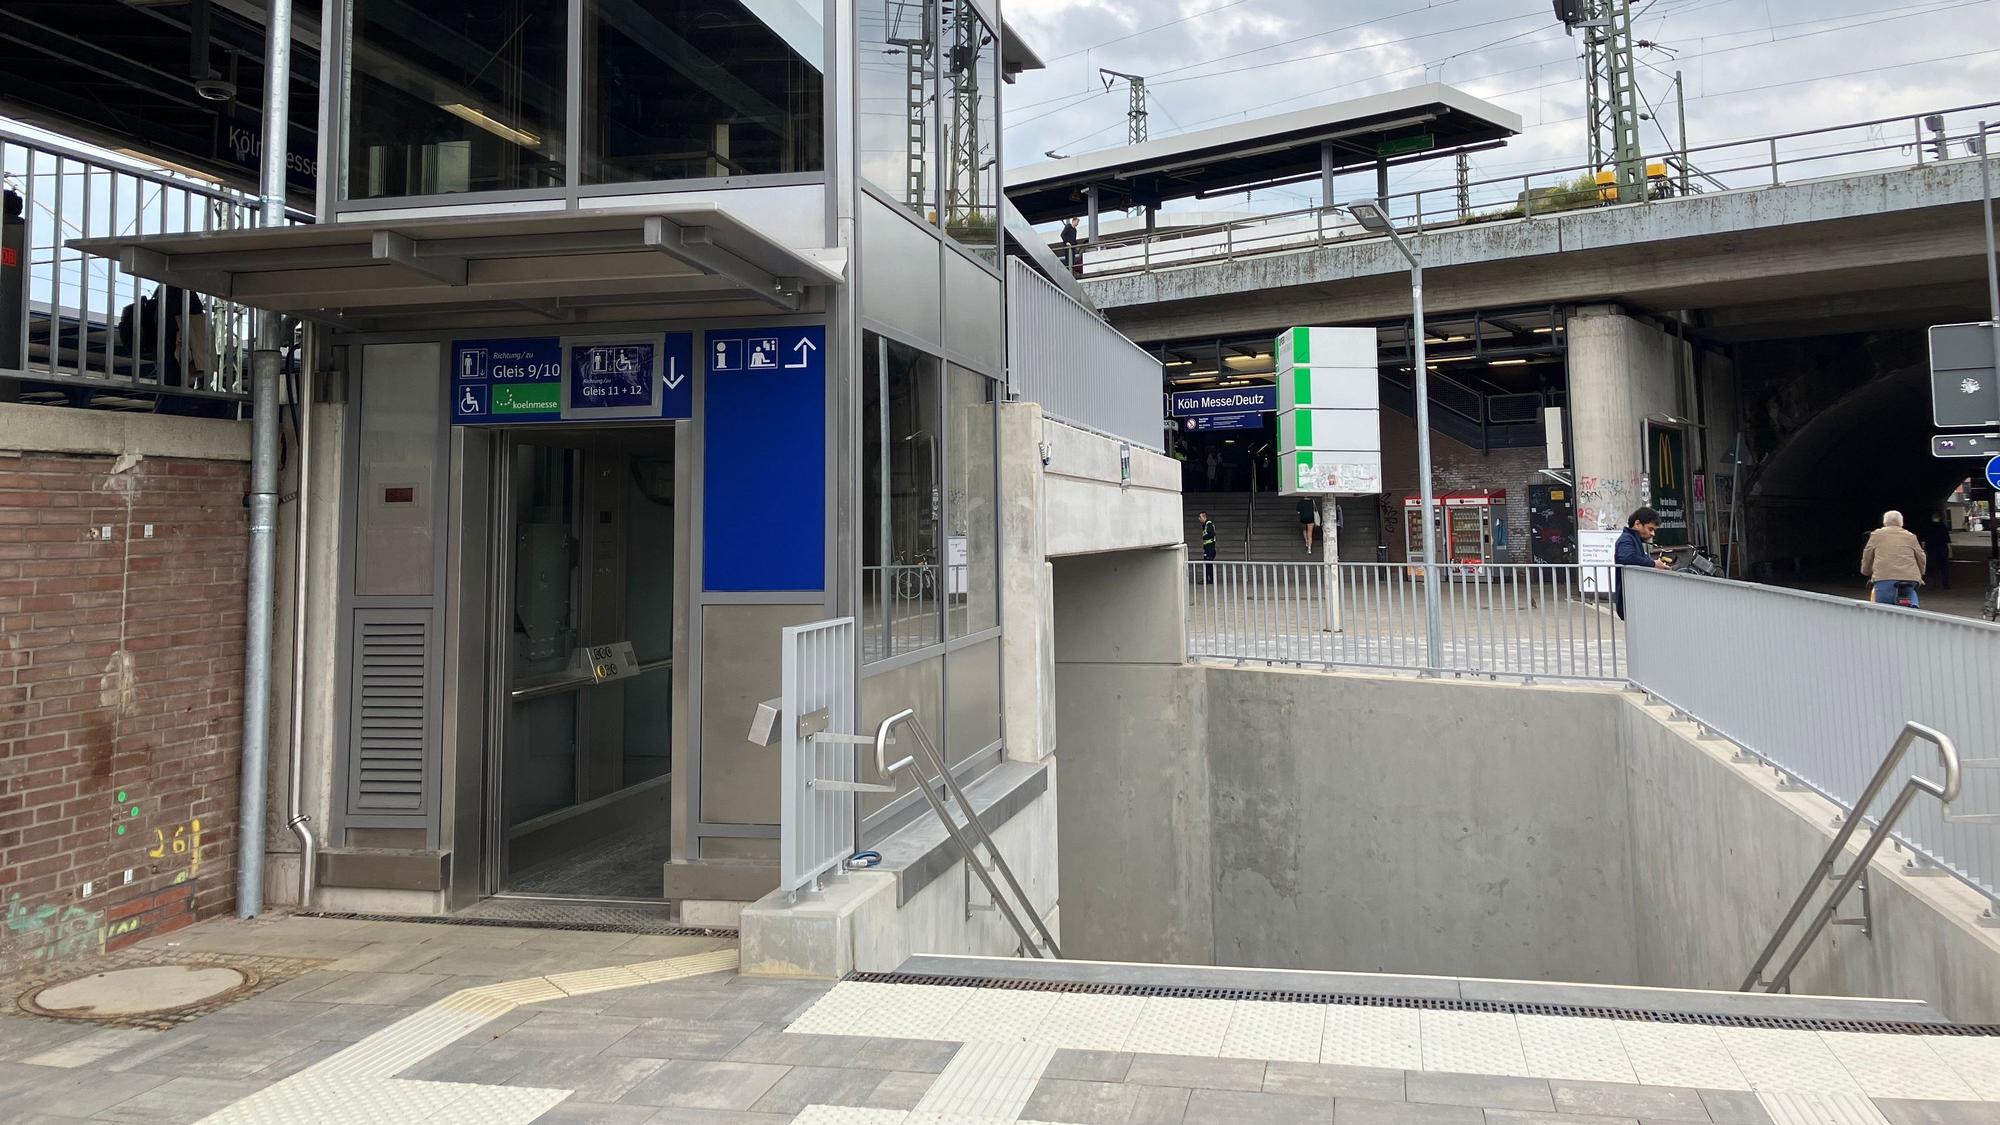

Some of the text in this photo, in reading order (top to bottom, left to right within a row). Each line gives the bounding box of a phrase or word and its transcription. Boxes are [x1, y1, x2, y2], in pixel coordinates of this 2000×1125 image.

[493, 363, 560, 379] Gleis 9/10
[583, 386, 606, 396] Gleis
[608, 386, 619, 395] 11
[630, 385, 642, 395] 12
[512, 400, 558, 409] koelnmesse
[1178, 394, 1264, 409] Köln Messe/Deutz
